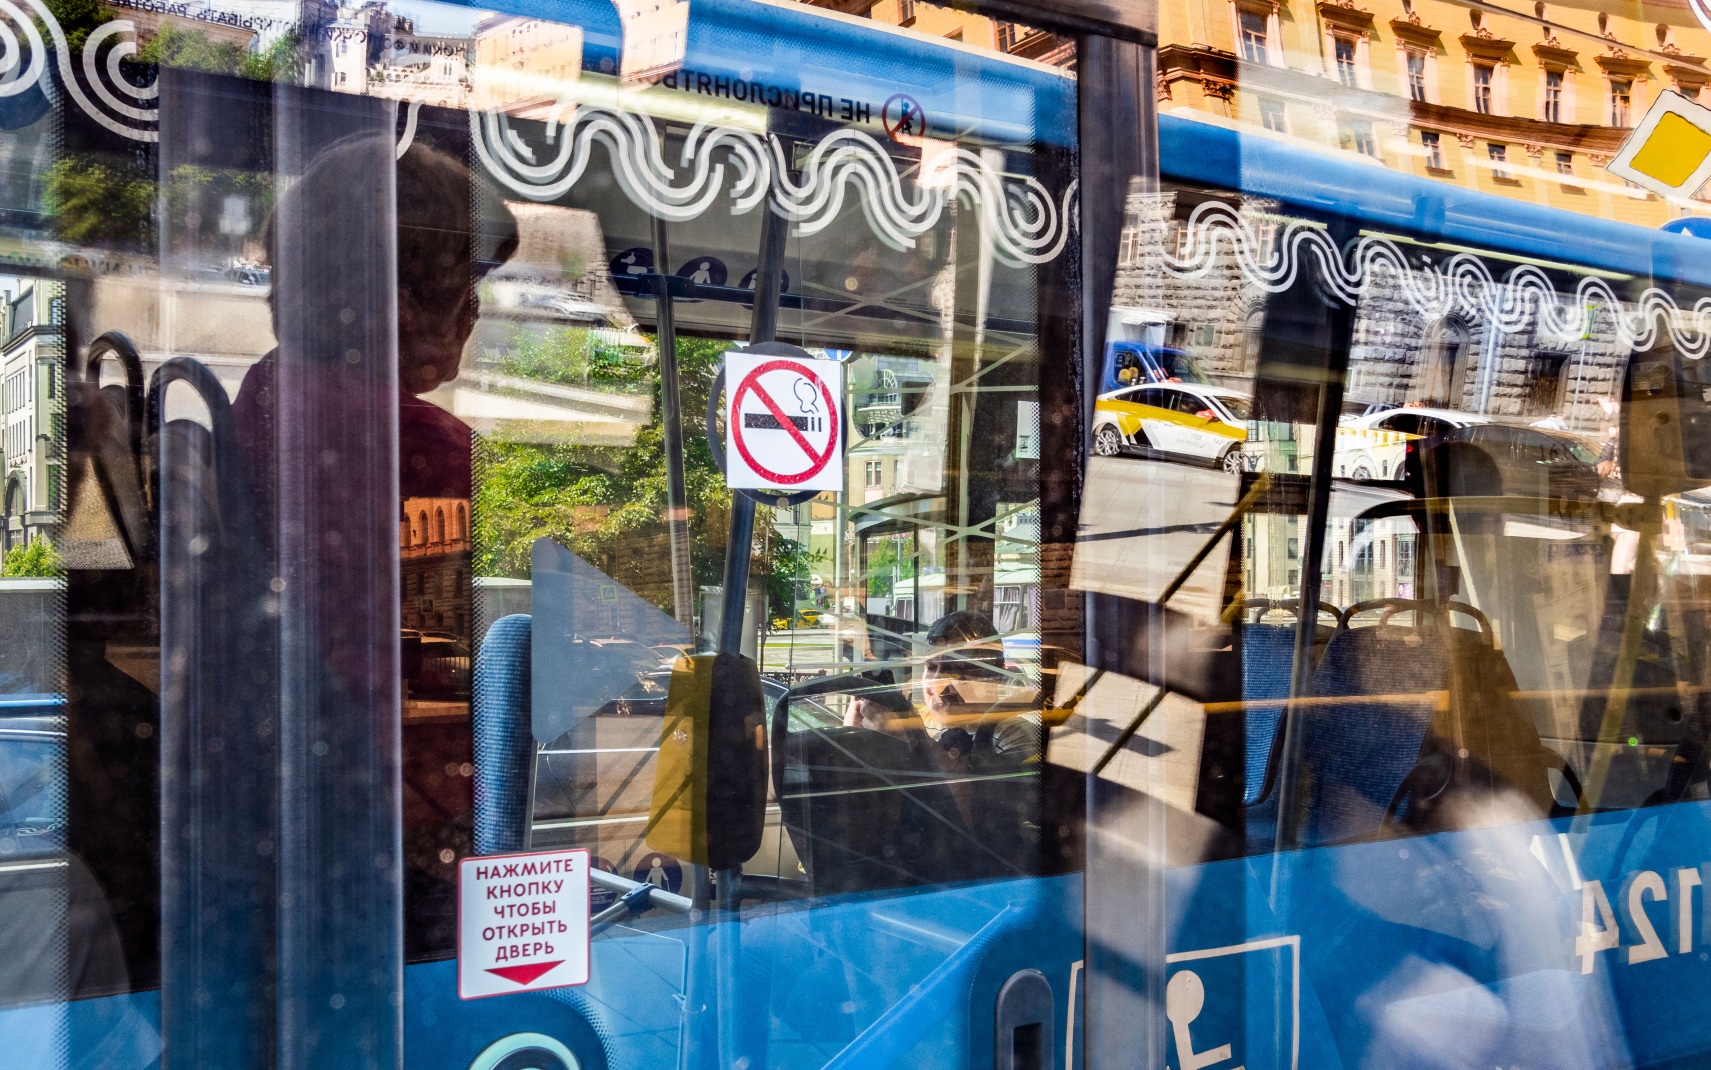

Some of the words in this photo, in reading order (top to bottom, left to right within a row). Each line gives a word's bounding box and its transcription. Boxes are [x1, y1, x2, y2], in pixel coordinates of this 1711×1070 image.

[476, 858, 574, 881] НАЖМИТЕ
[486, 879, 564, 900] КНОПКУ
[494, 900, 556, 919] ЧТОБЫ
[482, 920, 568, 941] ОТКРЫТЬ
[495, 941, 555, 963] ДВЕРЬ
